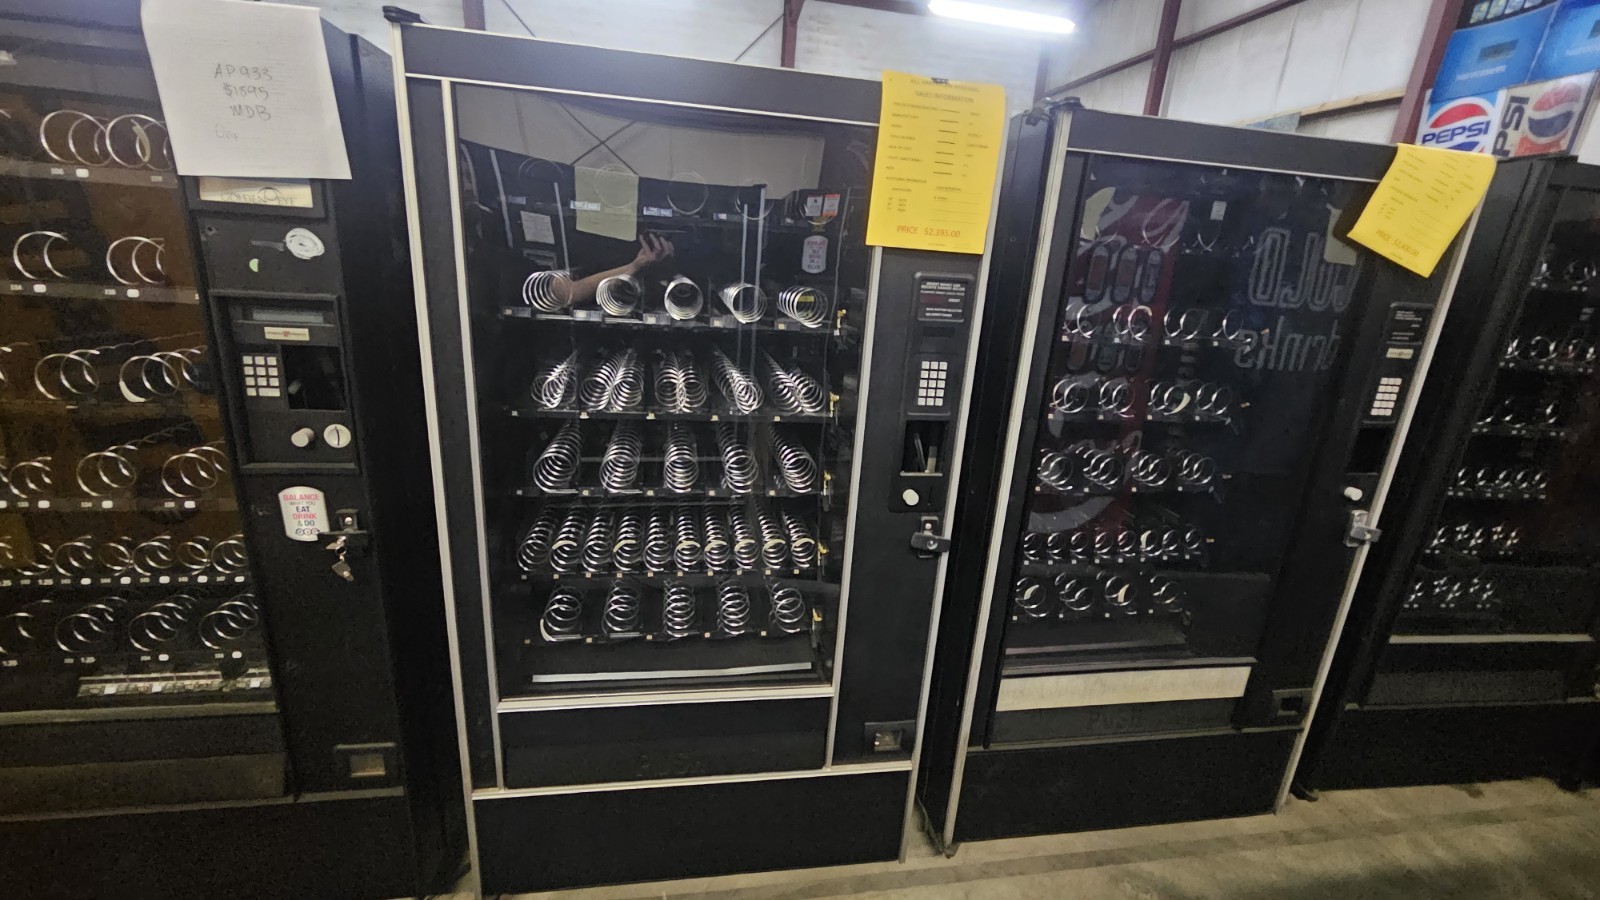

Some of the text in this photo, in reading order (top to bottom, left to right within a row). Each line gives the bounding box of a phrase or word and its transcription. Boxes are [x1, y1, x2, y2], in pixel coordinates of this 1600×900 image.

[229, 103, 272, 121] MDB
[1422, 120, 1491, 145] PEPSI
[896, 225, 961, 238] PRICE $2,395.00
[283, 494, 320, 502] BALANCE
